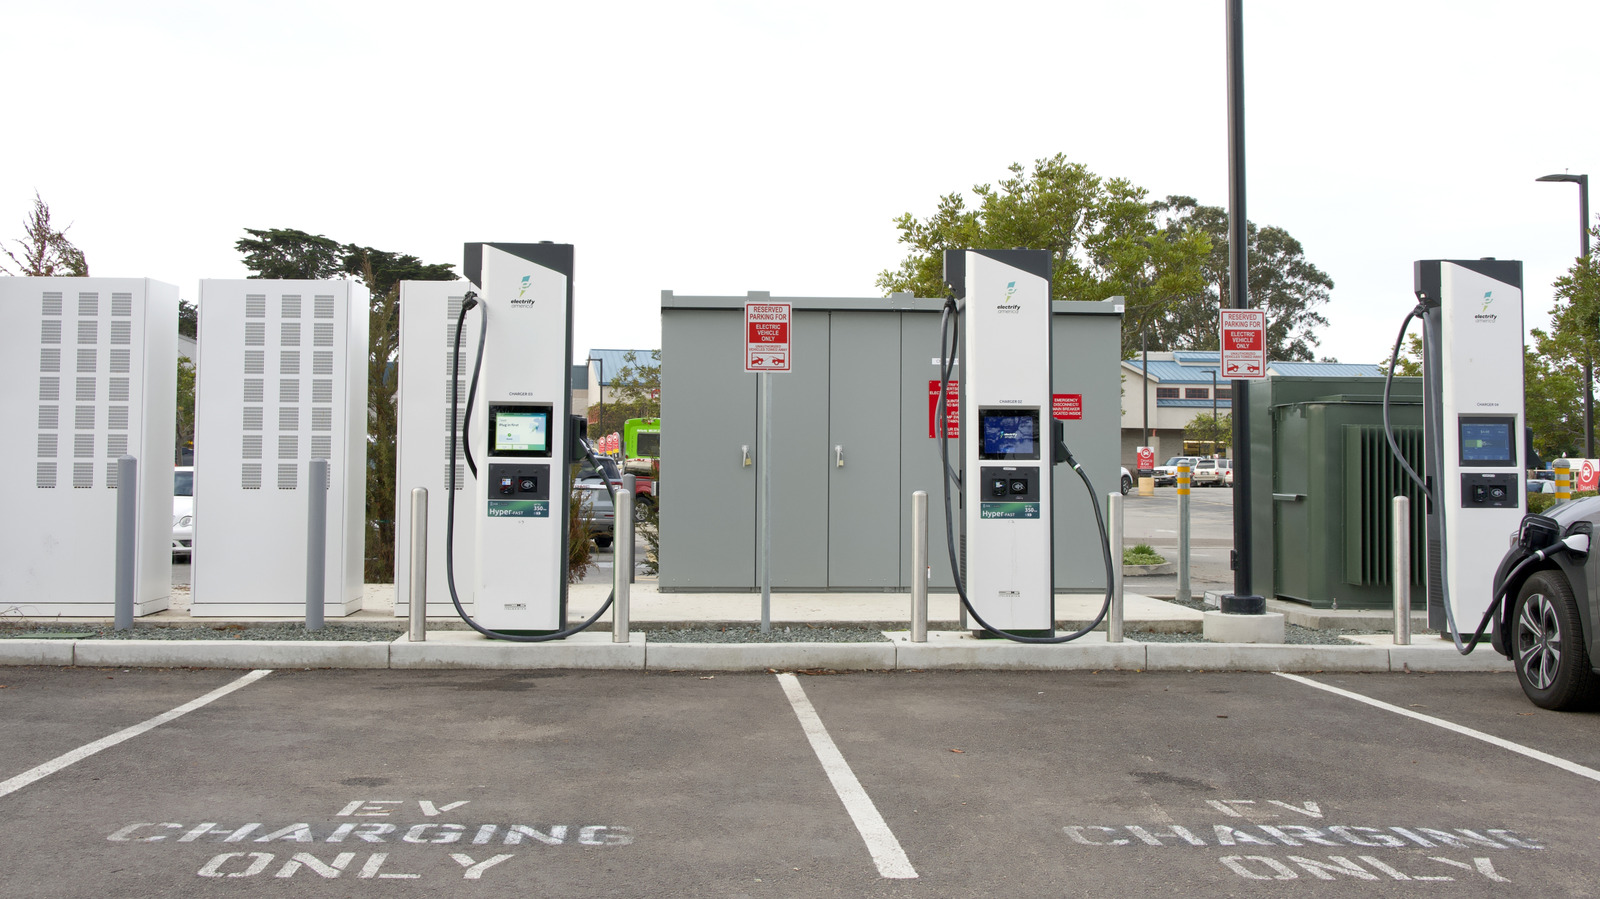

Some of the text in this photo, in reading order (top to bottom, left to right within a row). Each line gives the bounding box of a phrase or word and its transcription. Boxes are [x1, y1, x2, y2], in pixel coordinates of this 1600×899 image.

[335, 800, 471, 816] EV
[106, 822, 634, 845] CHARGING
[1062, 824, 1545, 849] CHARGING
[197, 852, 515, 879] ONLY
[1219, 855, 1512, 883] ONLY
